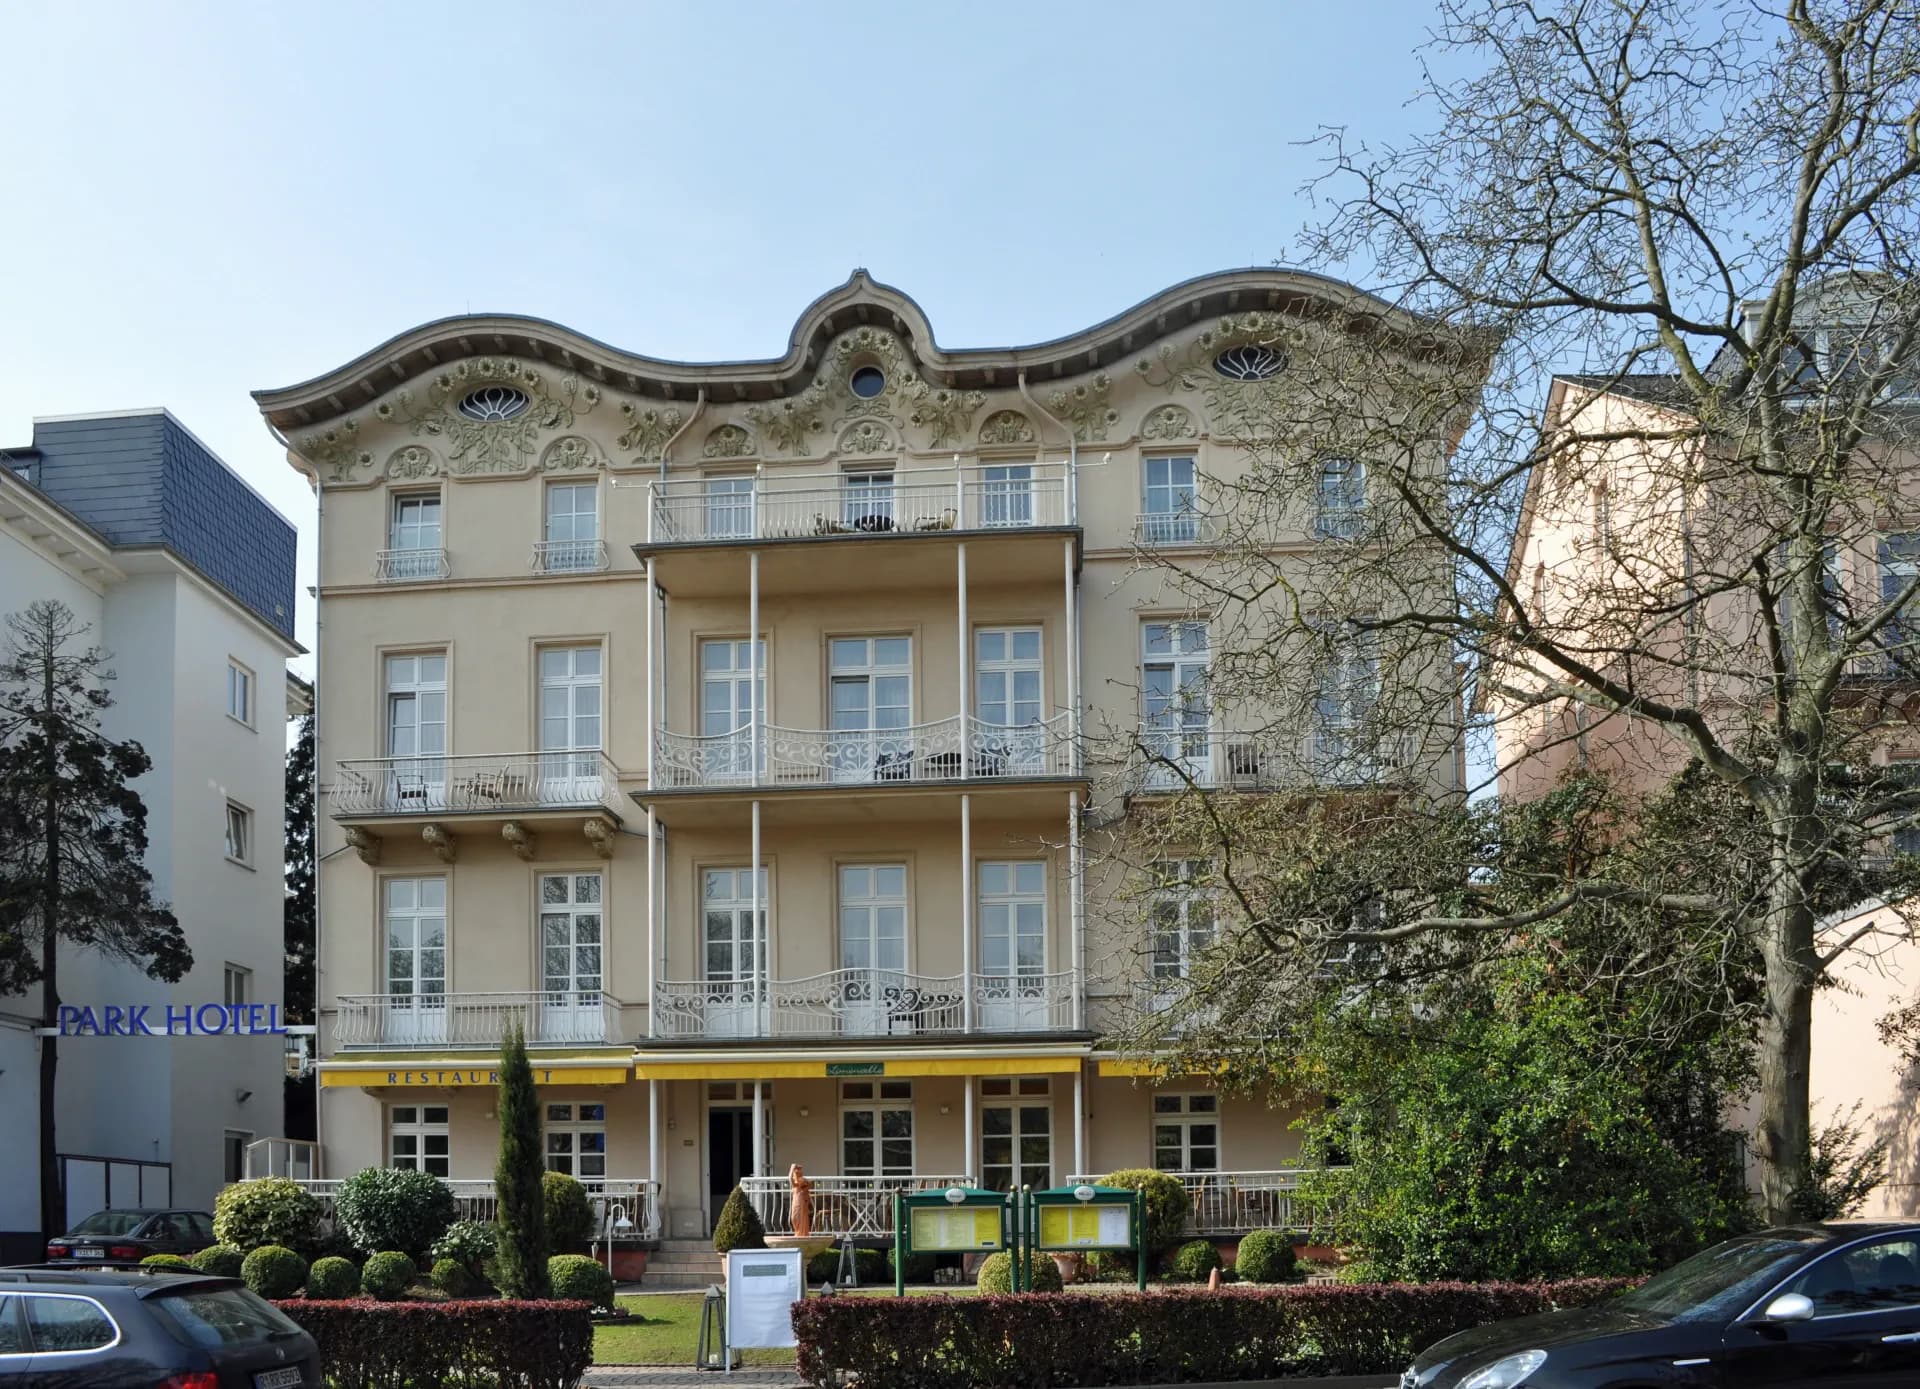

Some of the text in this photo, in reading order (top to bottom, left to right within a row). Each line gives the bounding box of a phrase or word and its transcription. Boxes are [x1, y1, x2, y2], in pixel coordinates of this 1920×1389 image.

[58, 1002, 289, 1036] PARK HOTEL
[387, 1070, 553, 1084] RESTAURT
